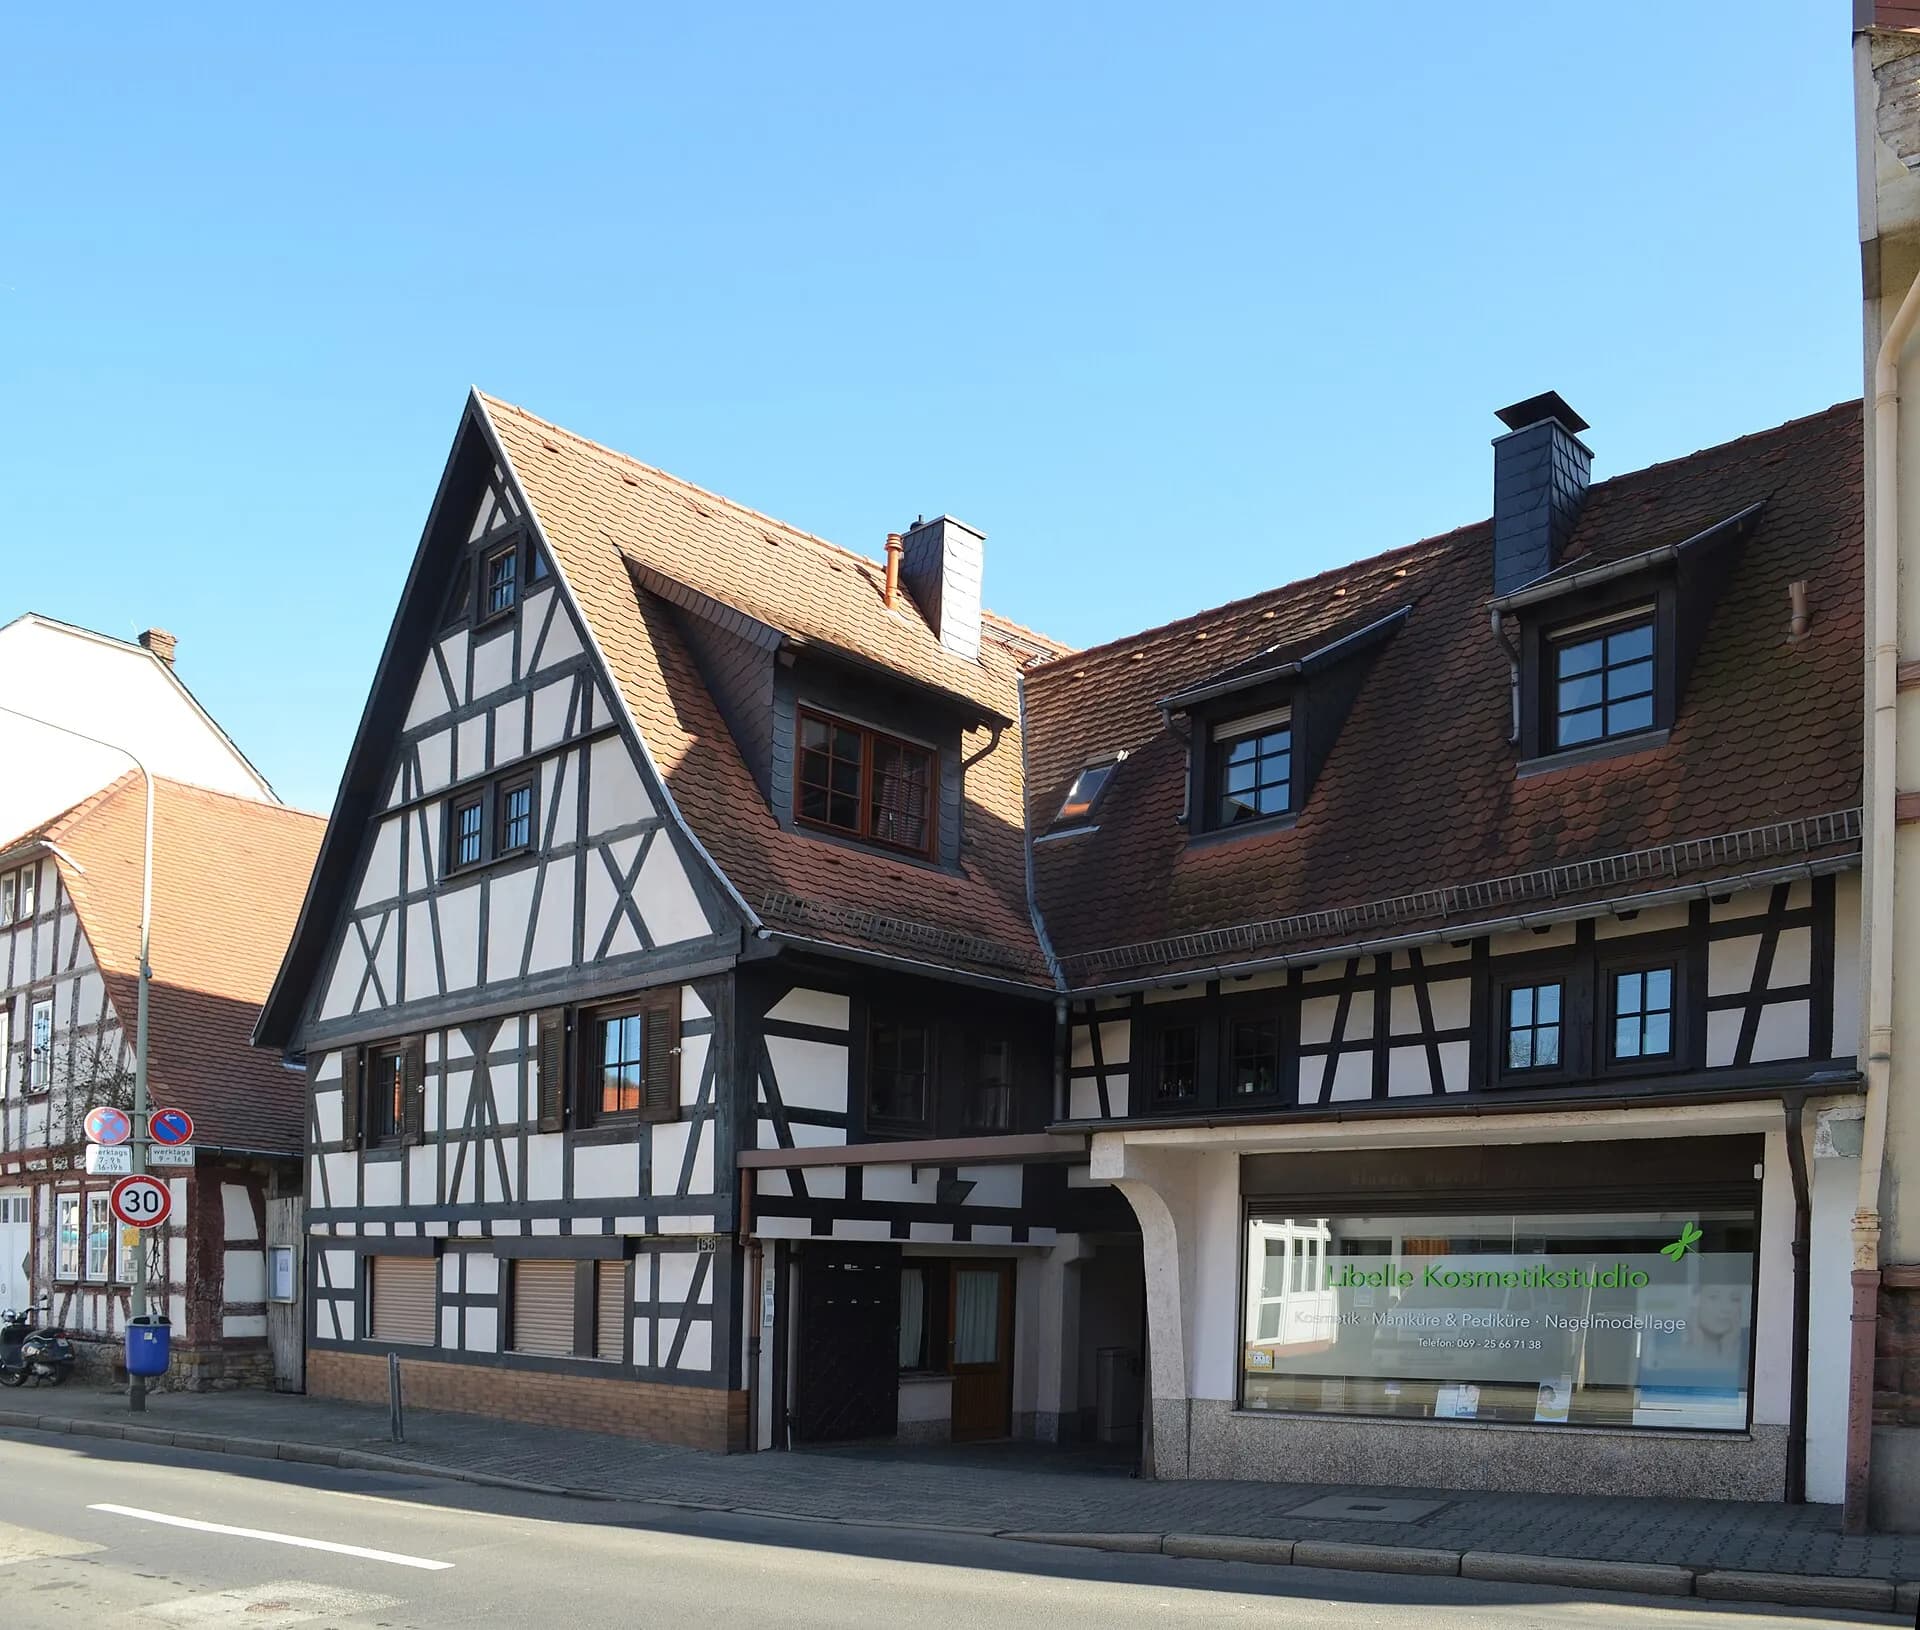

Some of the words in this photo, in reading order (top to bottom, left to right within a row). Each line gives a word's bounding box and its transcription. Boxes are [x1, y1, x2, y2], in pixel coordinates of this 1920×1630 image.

[95, 1149, 128, 1157] erktags
[153, 1149, 190, 1157] werktags
[125, 1190, 158, 1213] 30
[1327, 1263, 1414, 1288] Libelle
[1423, 1263, 1650, 1289] Kosmetikstudio
[1294, 1311, 1361, 1325] Kosmetik
[1372, 1311, 1441, 1327] Maniküre
[1444, 1312, 1457, 1327] &
[1462, 1312, 1530, 1328] Pediküre
[1545, 1314, 1686, 1334] Nagelmodellage
[1417, 1337, 1455, 1348] Telefon:
[1456, 1338, 1475, 1348] 069
[1484, 1340, 1497, 1349] 25
[1498, 1340, 1511, 1349] 66
[1513, 1340, 1525, 1349] 71
[1529, 1341, 1542, 1349] 38
